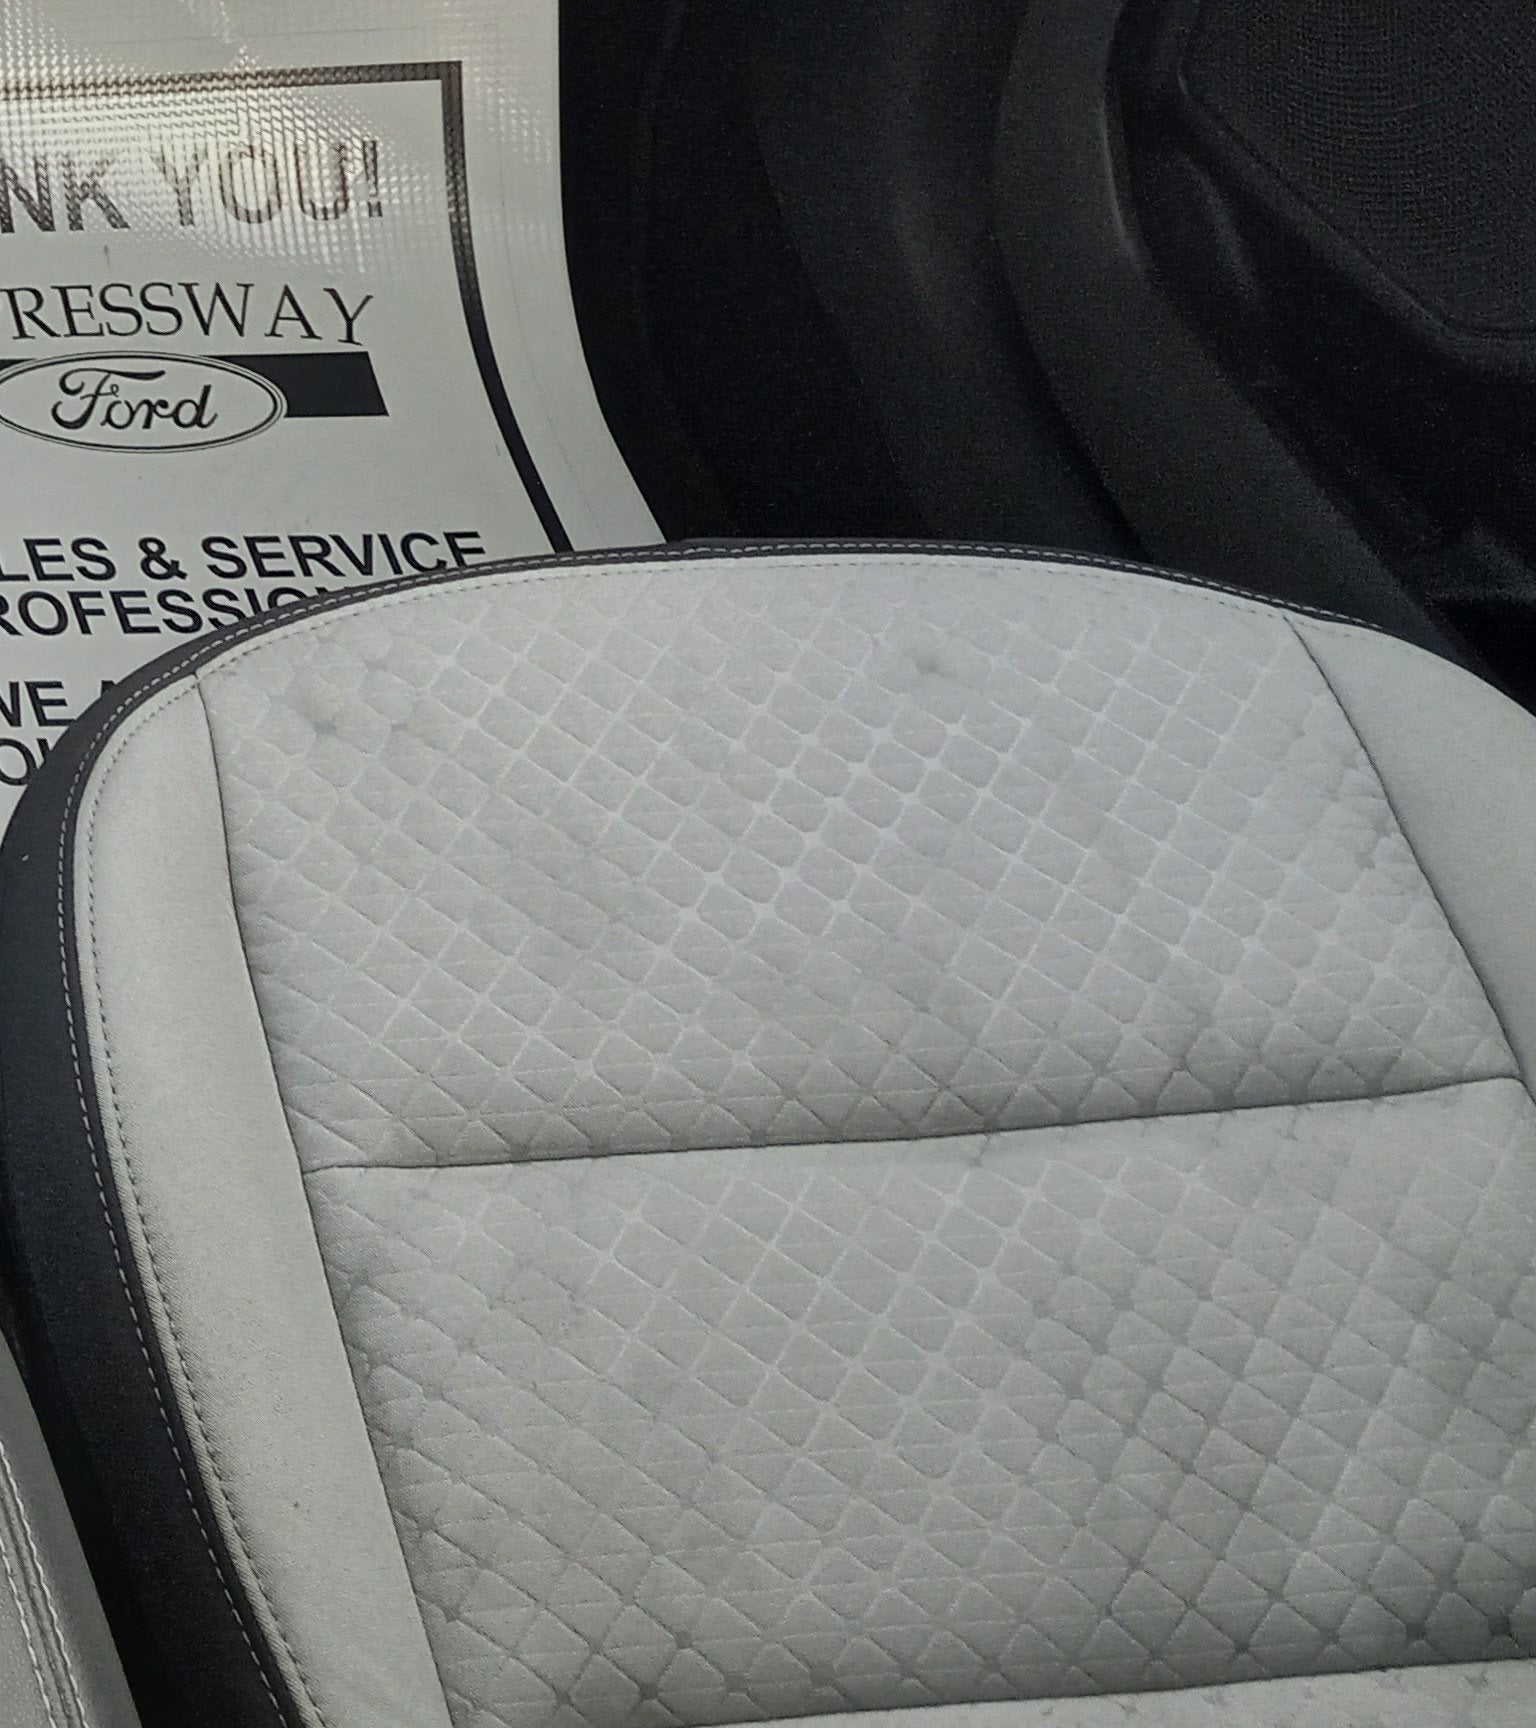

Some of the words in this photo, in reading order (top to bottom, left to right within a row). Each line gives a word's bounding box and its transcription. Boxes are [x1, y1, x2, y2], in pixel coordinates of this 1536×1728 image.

[149, 138, 383, 229] YOU!
[50, 366, 219, 433] Ford
[139, 535, 189, 581] &
[200, 530, 487, 580] SERVICE
